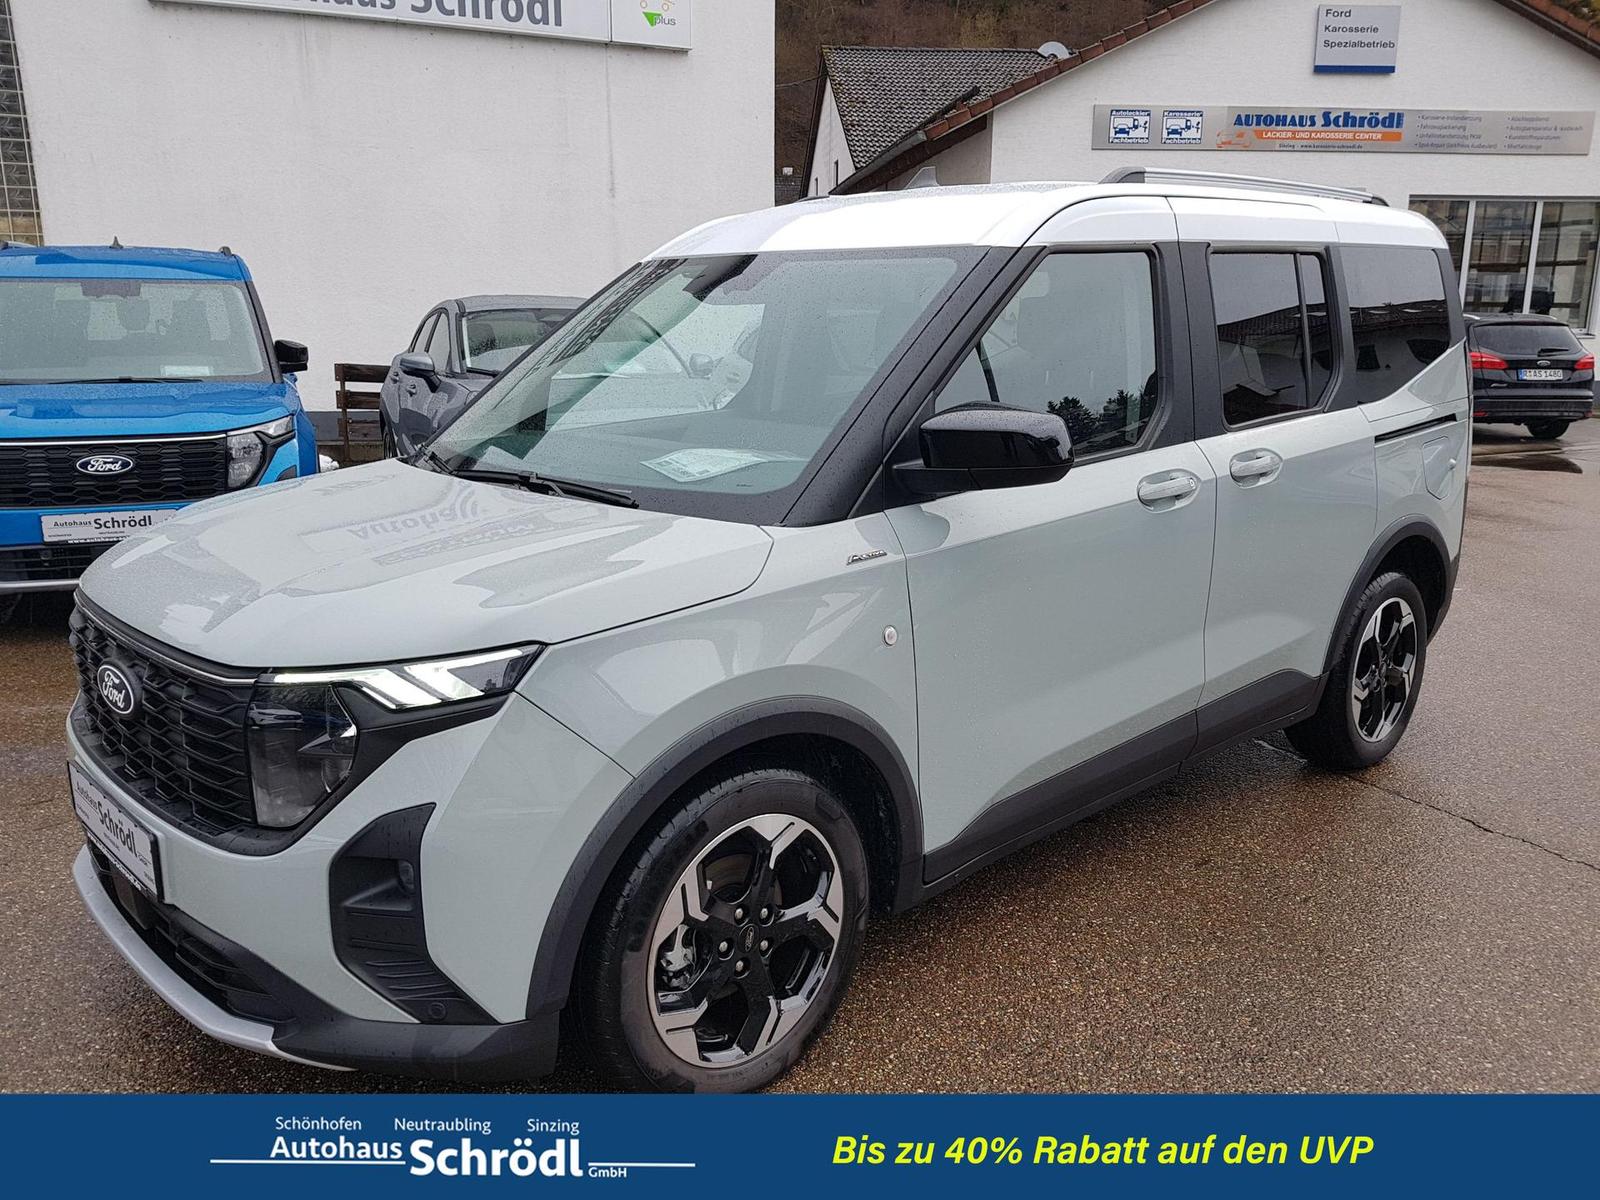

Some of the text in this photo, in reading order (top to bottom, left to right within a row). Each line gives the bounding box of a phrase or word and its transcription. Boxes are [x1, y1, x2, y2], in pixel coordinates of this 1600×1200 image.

[1325, 8, 1352, 18] Ford
[655, 16, 676, 26] plus
[1324, 25, 1379, 33] Karosserie
[1323, 40, 1395, 49] Spezialbetrieb
[1233, 111, 1404, 129] AUTOHAUS Schrödl
[1311, 132, 1354, 140] KAROSSERIE
[88, 458, 121, 471] Ford
[53, 515, 152, 529] Autohaus Schrödl
[103, 671, 125, 708] Ford
[97, 801, 138, 857] Schrödl
